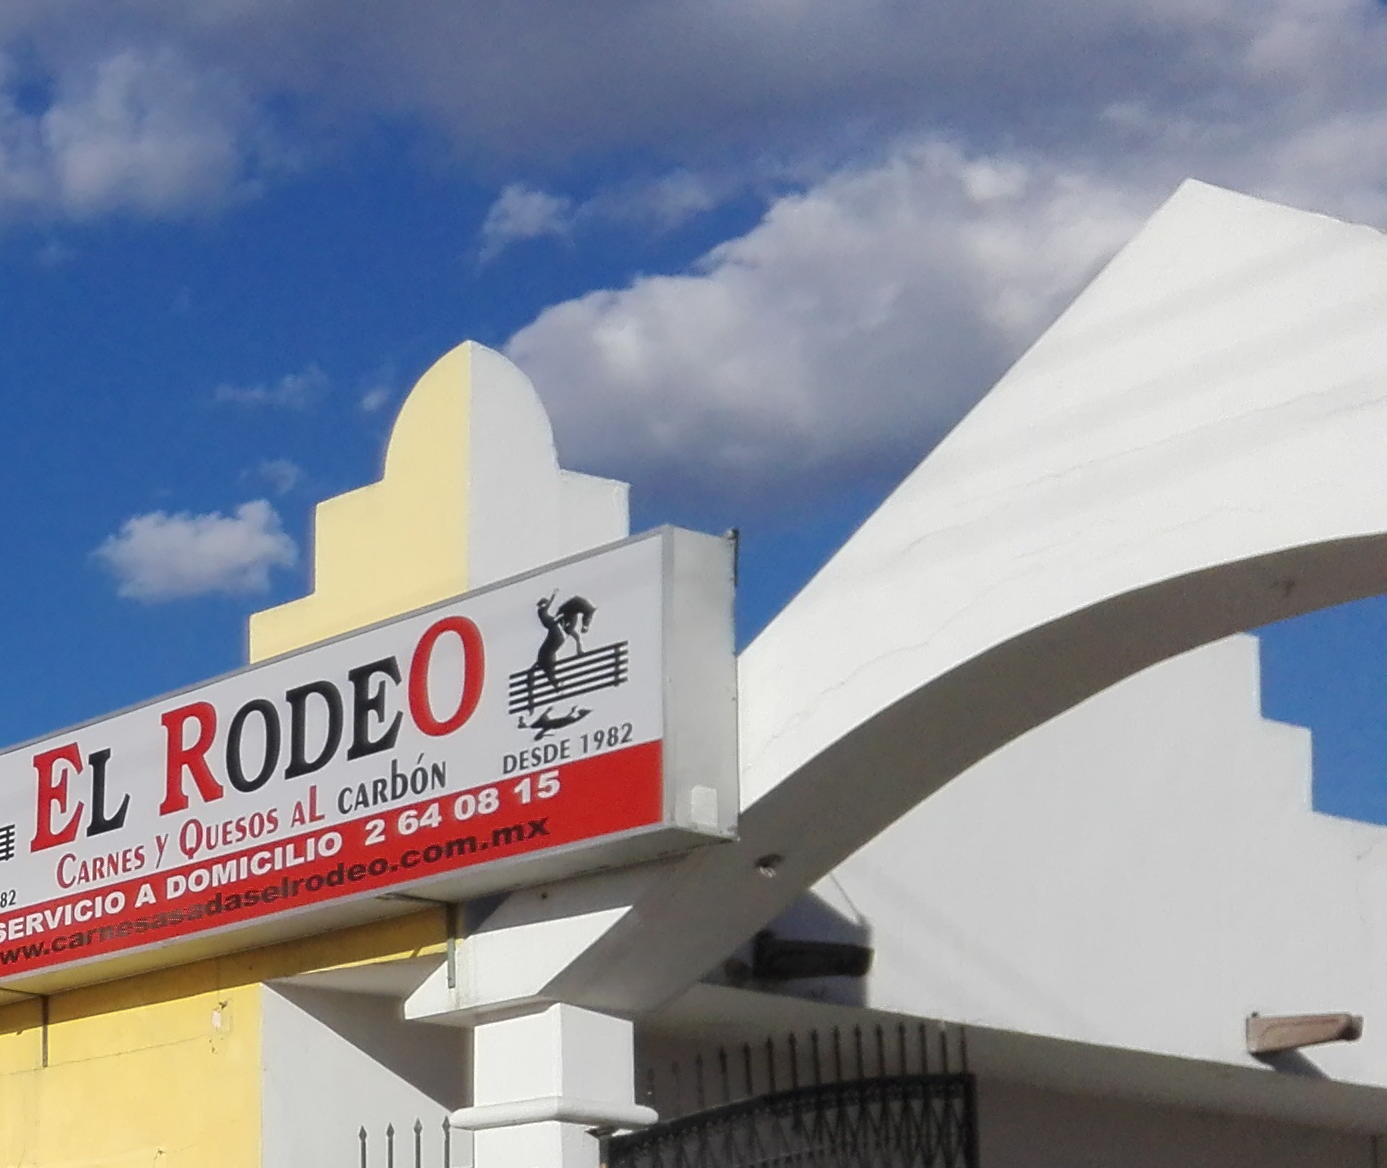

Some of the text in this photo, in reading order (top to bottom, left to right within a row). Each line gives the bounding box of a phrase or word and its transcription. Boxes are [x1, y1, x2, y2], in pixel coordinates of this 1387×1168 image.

[31, 616, 485, 853] EL RODEO
[502, 722, 634, 776] DESDE 1982
[134, 883, 158, 908] A
[165, 830, 344, 900] DOMICILIO
[364, 818, 386, 847] 2
[396, 802, 442, 836] 64
[452, 786, 500, 821] 08
[513, 769, 562, 804] 15
